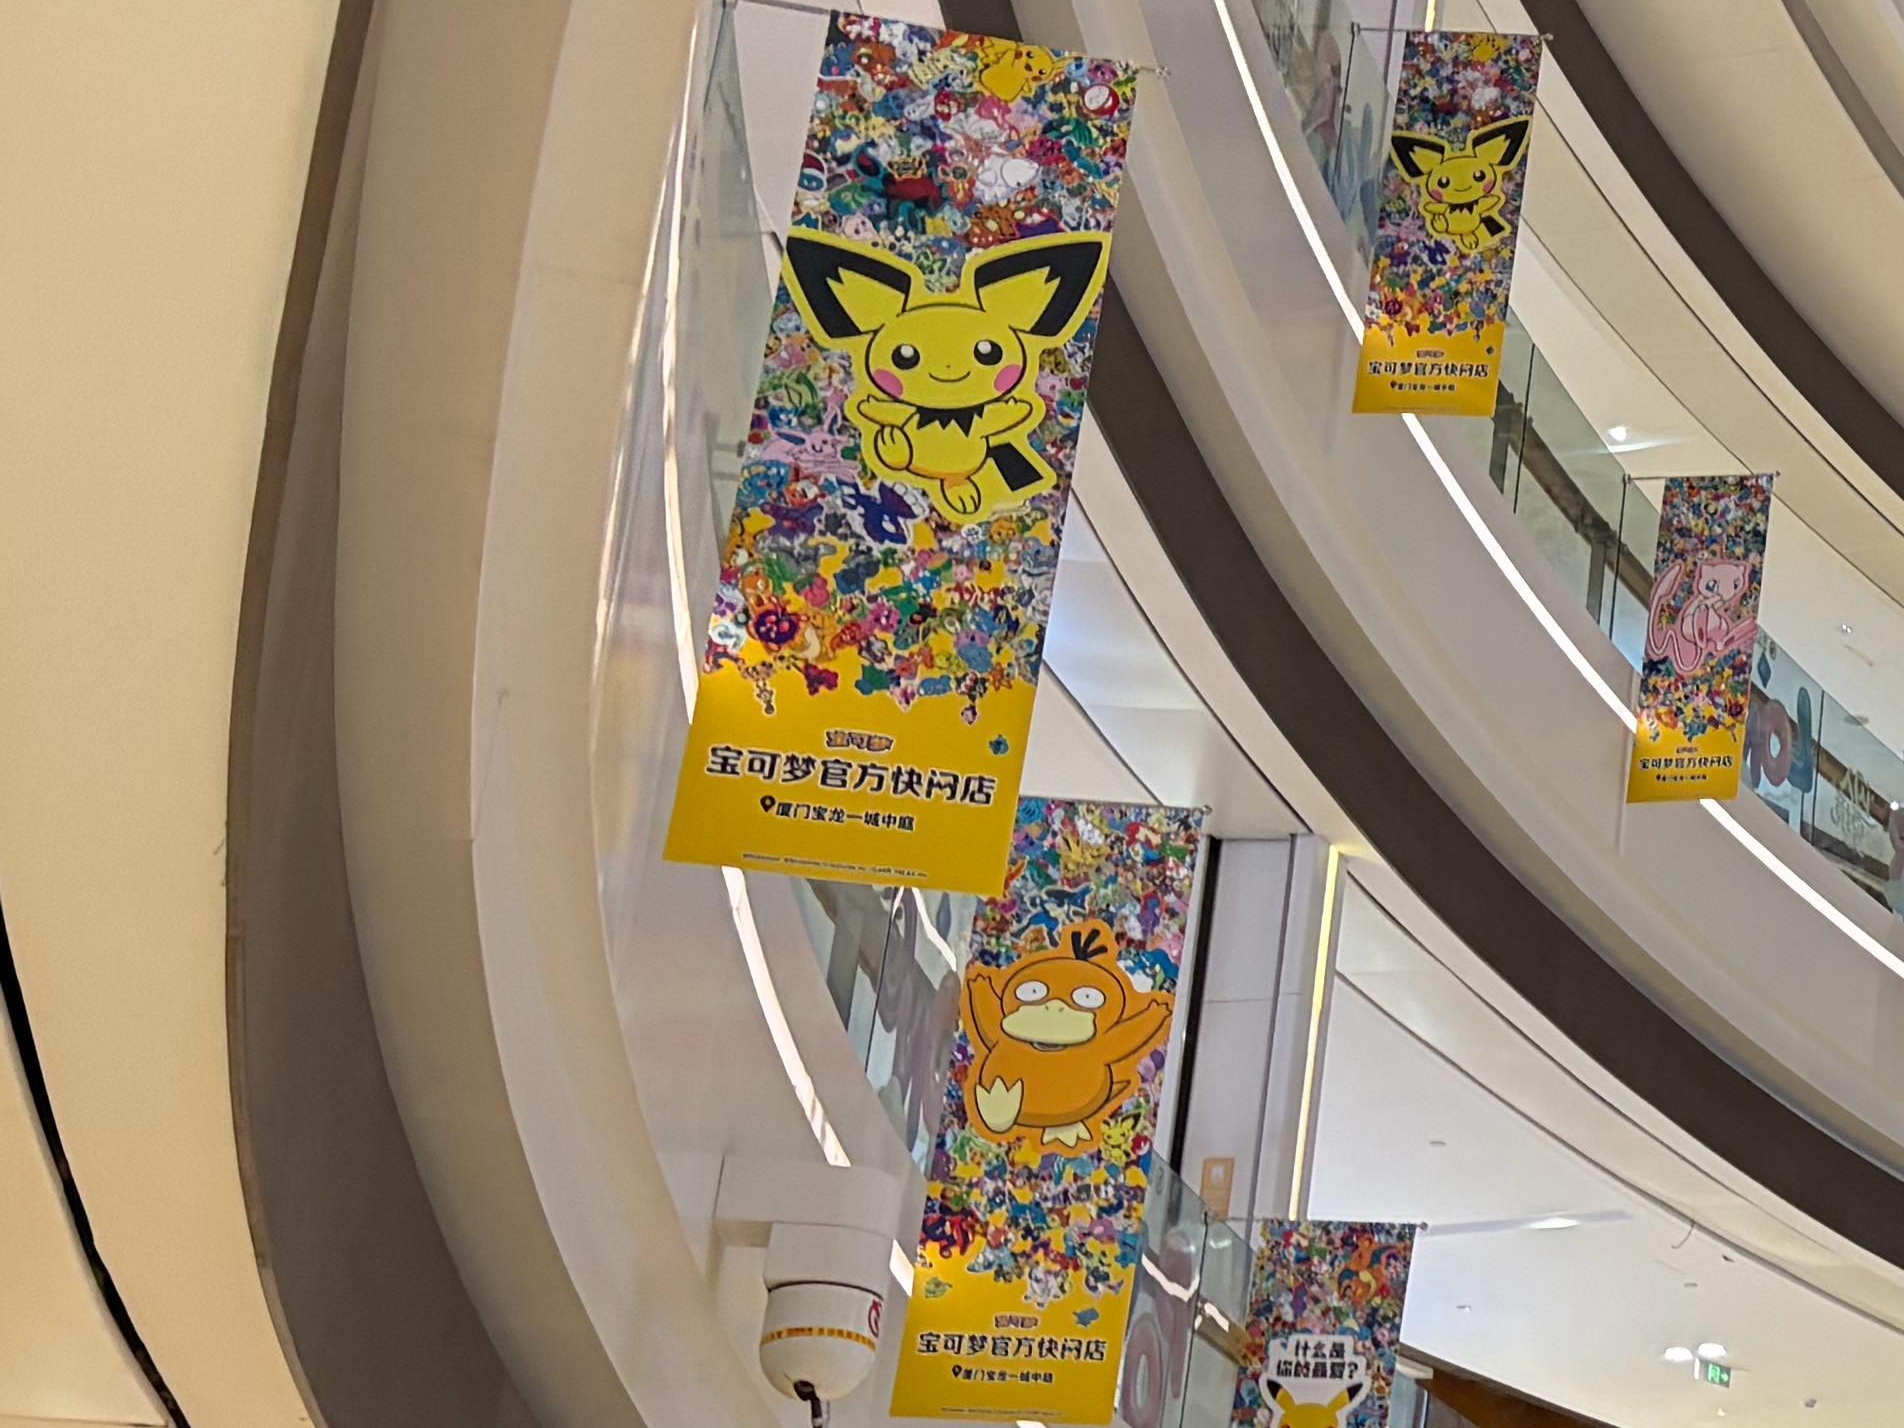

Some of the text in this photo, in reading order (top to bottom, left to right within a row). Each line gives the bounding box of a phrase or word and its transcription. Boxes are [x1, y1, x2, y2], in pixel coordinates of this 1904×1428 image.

[706, 744, 997, 806] 宝可梦官方快闪店
[775, 801, 915, 832] 厦门宝龙一城中庭
[917, 1332, 1107, 1362] 宝可梦官方快闪店
[1295, 1340, 1345, 1360] 什么是
